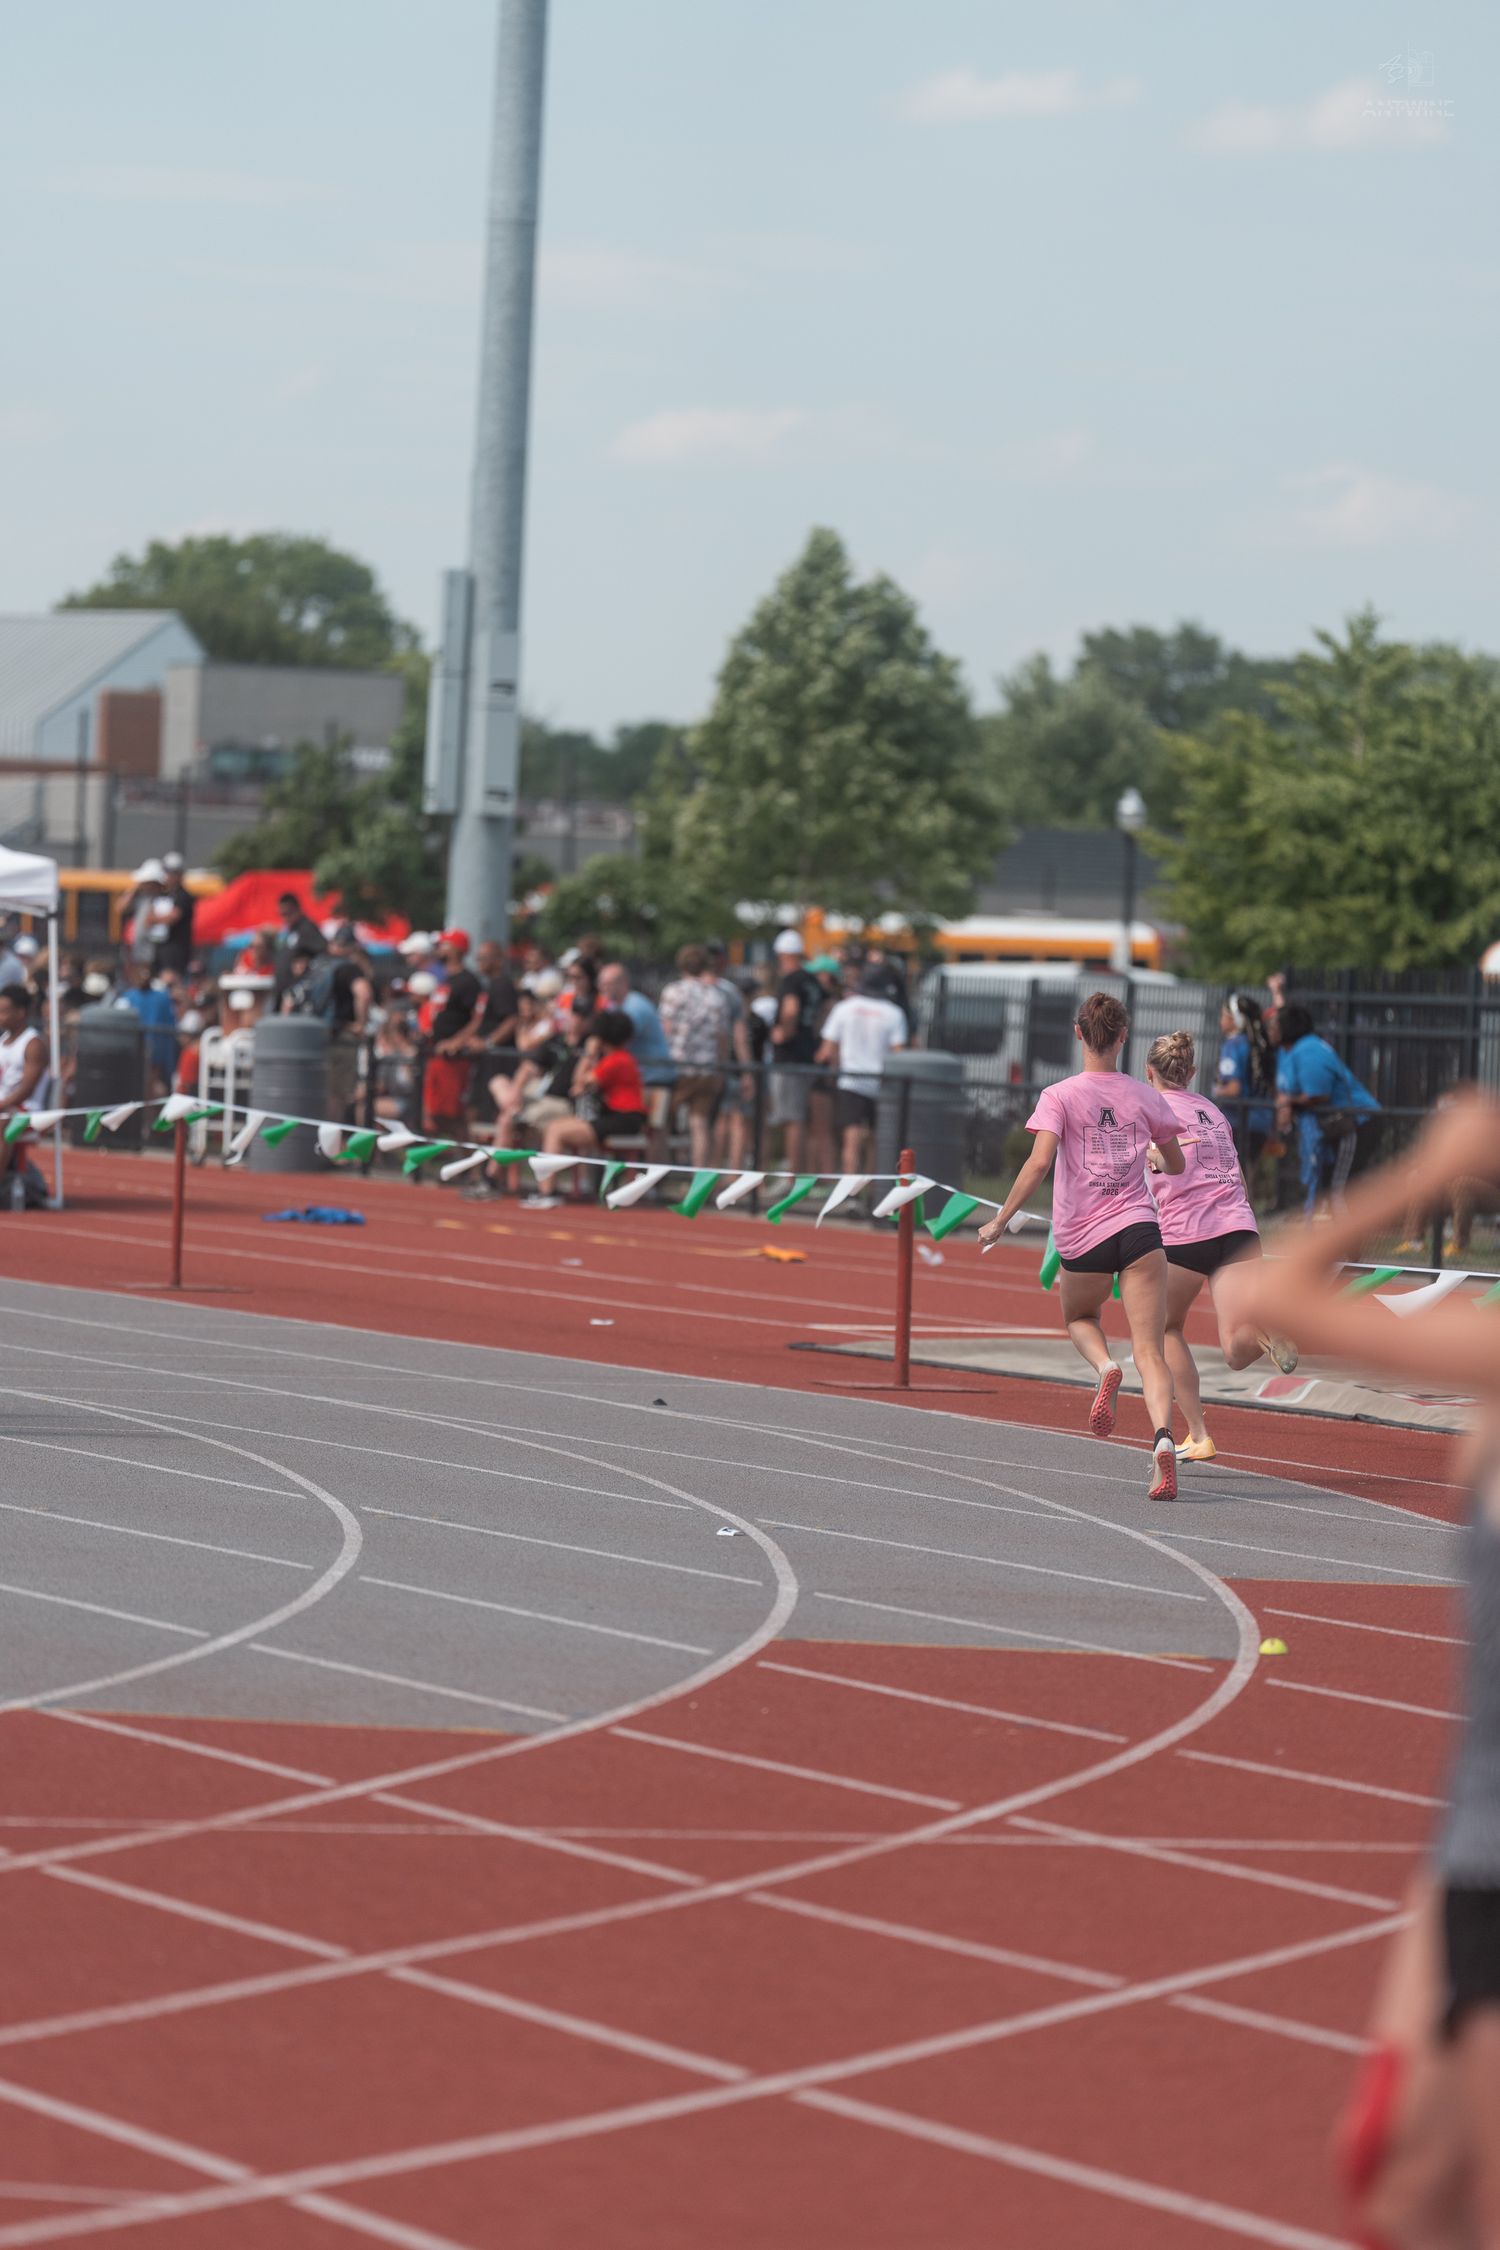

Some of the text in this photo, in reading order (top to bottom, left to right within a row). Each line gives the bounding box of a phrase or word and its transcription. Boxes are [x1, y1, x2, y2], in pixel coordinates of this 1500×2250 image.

[1098, 1107, 1118, 1127] A
[1194, 1109, 1215, 1125] A
[1101, 1188, 1119, 1196] 2026
